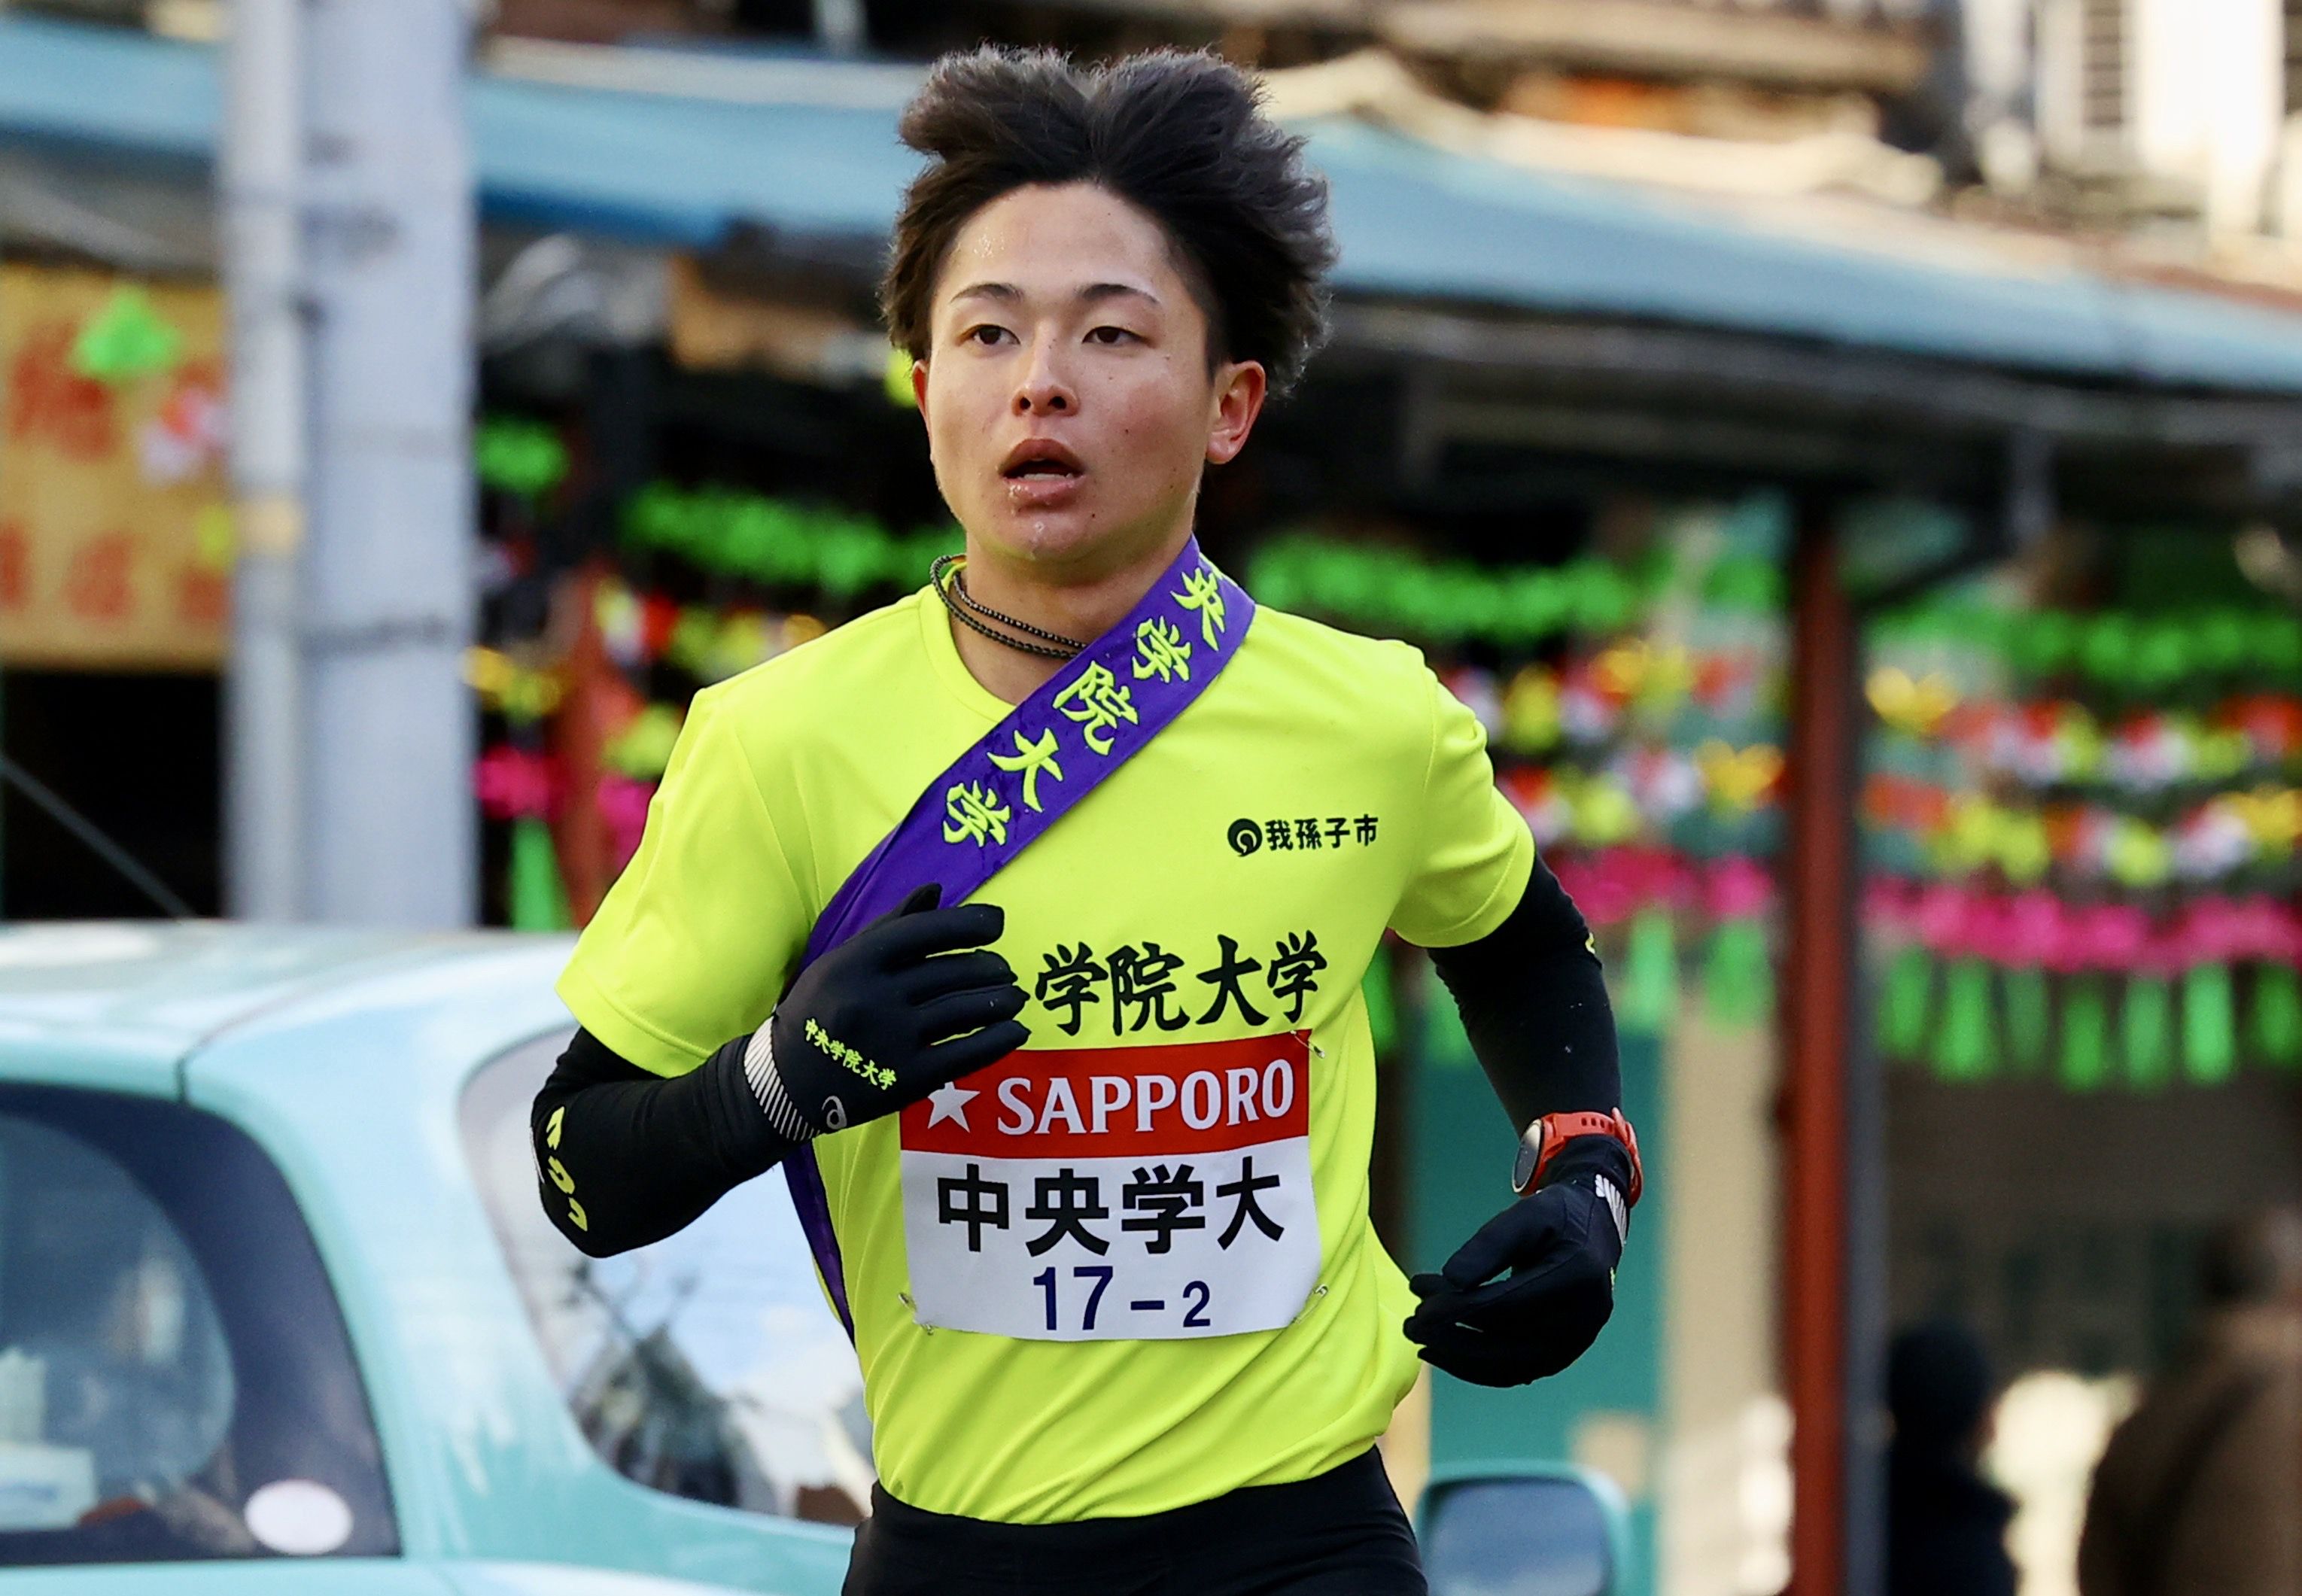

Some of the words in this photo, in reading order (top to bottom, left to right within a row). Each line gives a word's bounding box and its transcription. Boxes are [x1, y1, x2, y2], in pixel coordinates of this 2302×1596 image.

[1264, 813, 1379, 851] 我孫子市
[1035, 930, 1327, 1037] 学院大学
[804, 1017, 897, 1090] 中央学院大学
[996, 1058, 1294, 1135] SAPPORO
[937, 1156, 1285, 1257] 中央学大
